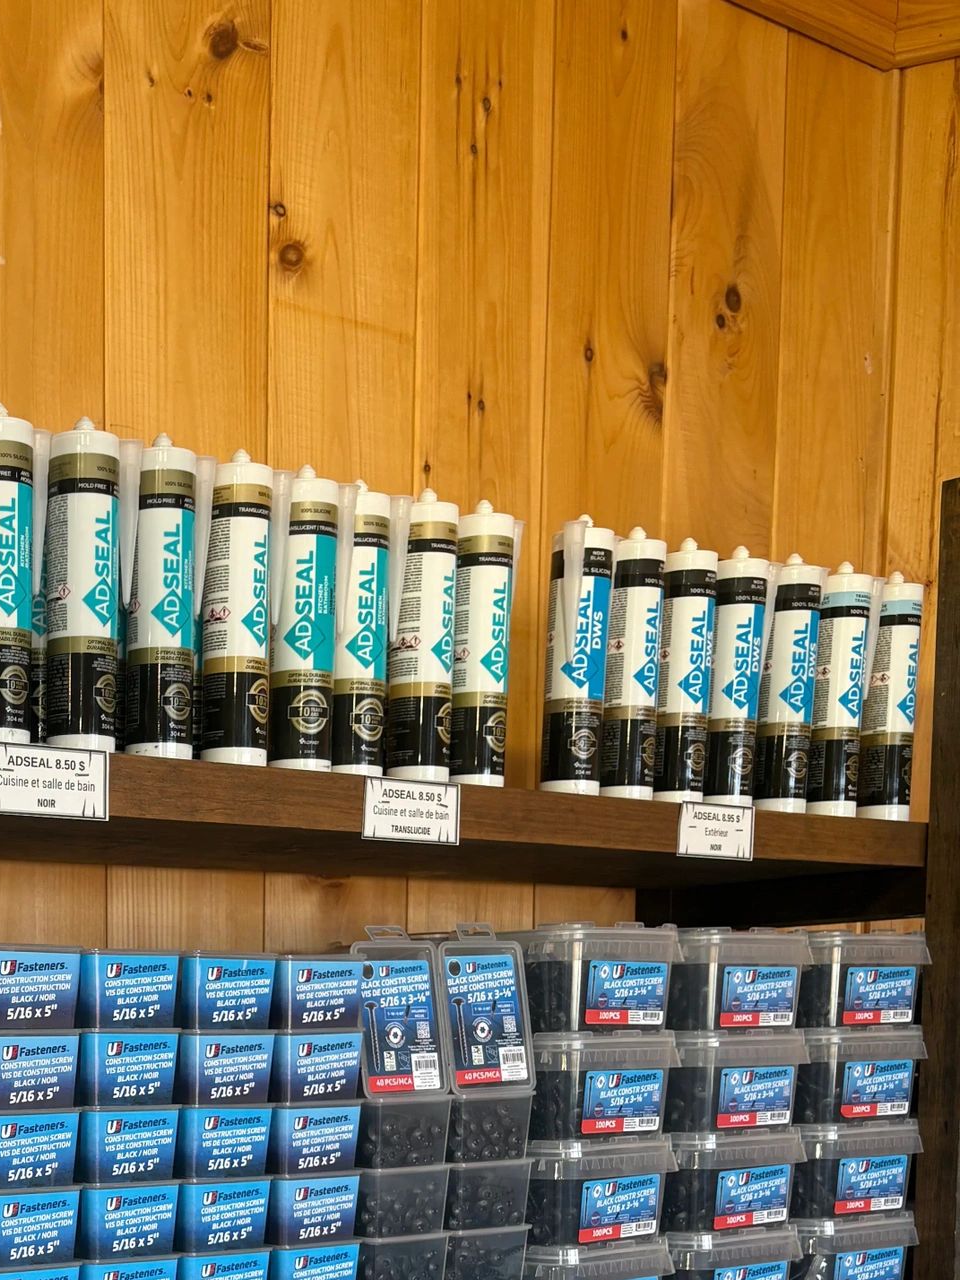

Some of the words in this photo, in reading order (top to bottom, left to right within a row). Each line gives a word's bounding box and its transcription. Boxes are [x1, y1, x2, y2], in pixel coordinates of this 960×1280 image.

[572, 590, 591, 682] ADSEAL
[592, 611, 603, 649] DWS
[8, 755, 52, 768] ADSEAL
[56, 759, 76, 770] 8.50
[79, 761, 85, 771] $
[31, 778, 40, 788] et
[42, 779, 62, 790] salle
[65, 780, 75, 790] de
[77, 782, 95, 792] bain
[382, 788, 417, 800] ADSEAL
[418, 792, 435, 802] 8.50
[437, 793, 442, 802] $
[37, 798, 56, 808] NOIR
[693, 812, 720, 821] ADSEAL
[722, 814, 734, 822] 8.95
[392, 825, 431, 835] TRANSLUCIDE
